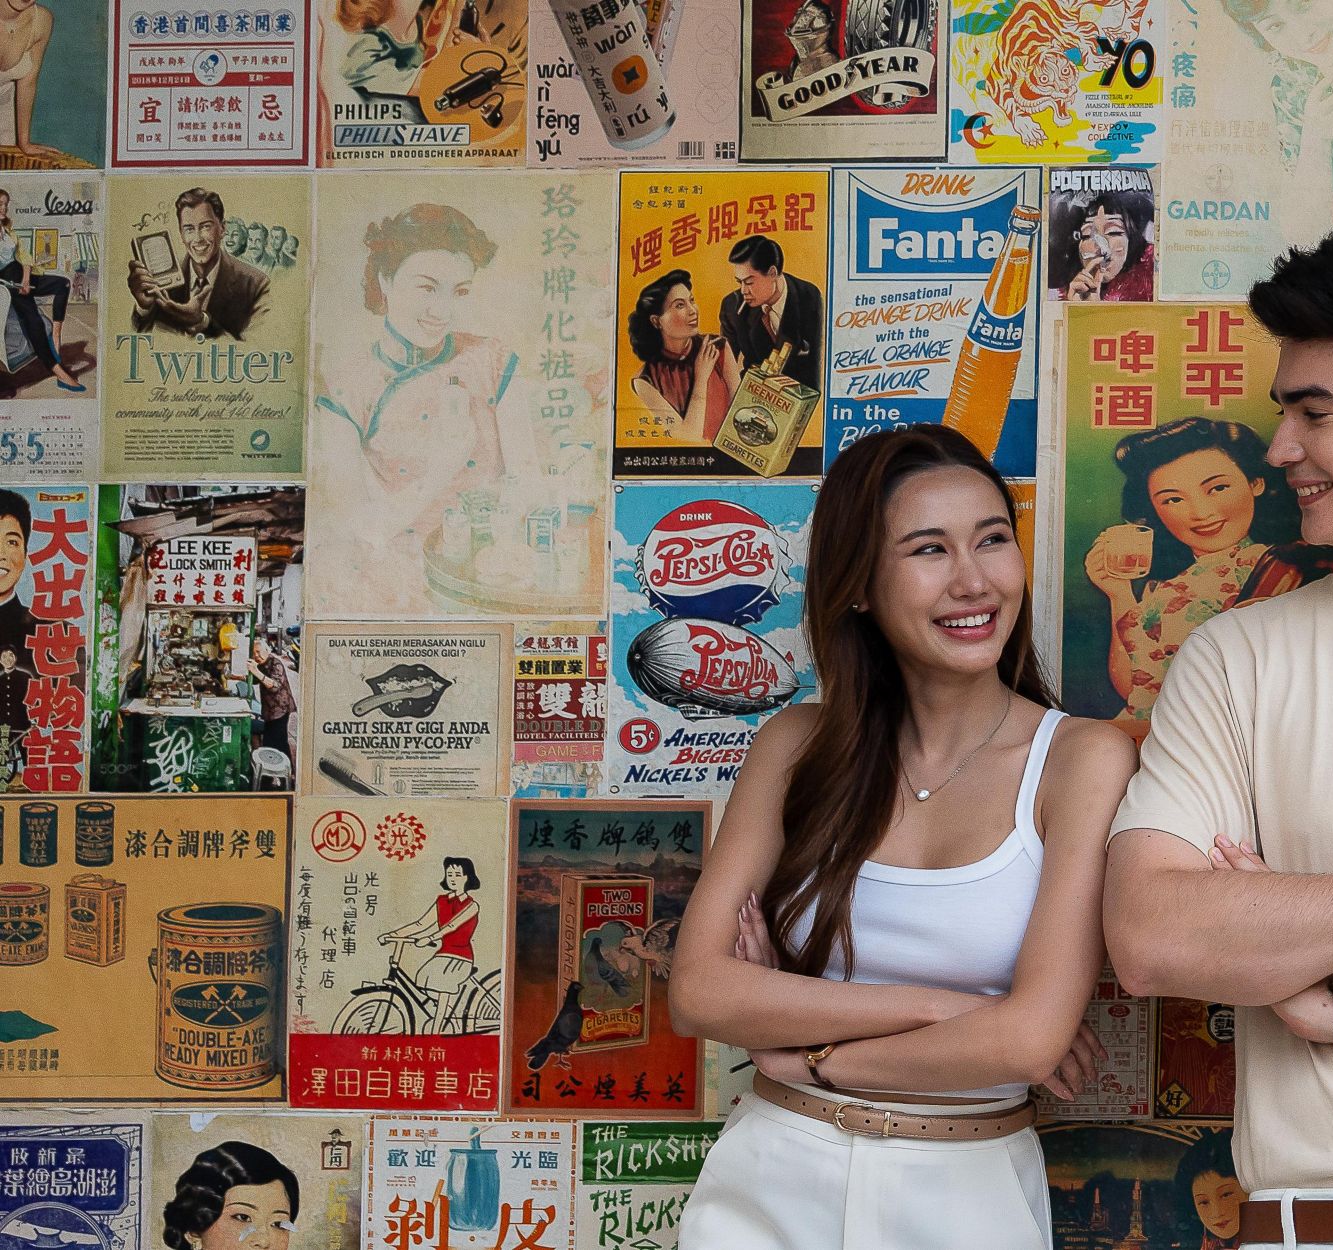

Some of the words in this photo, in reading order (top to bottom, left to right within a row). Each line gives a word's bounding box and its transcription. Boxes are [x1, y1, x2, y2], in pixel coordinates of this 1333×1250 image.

[138, 97, 162, 124] 宜
[258, 94, 283, 121] 忌
[334, 103, 402, 120] PHILIPS
[1088, 132, 1134, 141] COLLECTIVE
[1097, 123, 1121, 131] EXPO
[900, 172, 977, 196] DRINK
[15, 206, 42, 215] roulez
[44, 188, 94, 216] Vespa
[1167, 200, 1270, 221] GARDAN
[868, 217, 1004, 268] Fanta
[855, 293, 876, 307] the
[880, 284, 953, 304] sensational
[835, 302, 915, 329] ORANGE
[914, 296, 973, 321] DRINK
[876, 328, 904, 344] with
[908, 325, 930, 340] the
[971, 310, 1024, 342] Fanta
[115, 332, 294, 385] Twitter
[834, 347, 878, 370] REAL
[882, 338, 954, 363] ORANGE
[1186, 311, 1245, 406] 北平
[847, 366, 930, 396] FLAVOUR
[1093, 330, 1154, 426] 啤酒
[148, 387, 169, 402] The
[215, 388, 253, 405] mighty
[747, 380, 792, 413] KEENIEN
[115, 407, 174, 422] community
[176, 405, 200, 419] with
[200, 407, 225, 421] just
[832, 405, 853, 421] in
[864, 403, 900, 420] the
[679, 512, 712, 522] DRINK
[168, 541, 197, 555] LEE
[202, 540, 233, 555] KEE
[169, 558, 197, 570] LOCK
[199, 558, 232, 571] SMITH
[329, 639, 347, 647] DUA
[349, 639, 368, 647] KALI
[369, 639, 401, 647] SEHARI
[402, 639, 457, 647] MERASAKAN
[459, 639, 486, 647] NGILU
[350, 649, 381, 657] KETIKA
[383, 649, 439, 657] MENGGOSOK
[441, 649, 460, 657] GIGI
[323, 721, 368, 735] GANTI
[372, 721, 412, 735] SIKAT
[416, 721, 445, 735] GIGI
[447, 721, 490, 735] ANDA
[516, 720, 585, 732] DOUBLE
[342, 736, 400, 749] DENGAN
[535, 745, 578, 757] GAME
[669, 747, 747, 765] BIGGES
[624, 764, 707, 783] NICKEL'S
[602, 889, 632, 903] TWO
[587, 903, 644, 917] PIGEONS
[319, 927, 337, 989] 代理店
[206, 1048, 249, 1068] MIXED
[593, 1125, 628, 1146] THE
[387, 1149, 437, 1168] 歡迎
[511, 1150, 558, 1170] 光臨
[590, 1189, 632, 1214] THE
